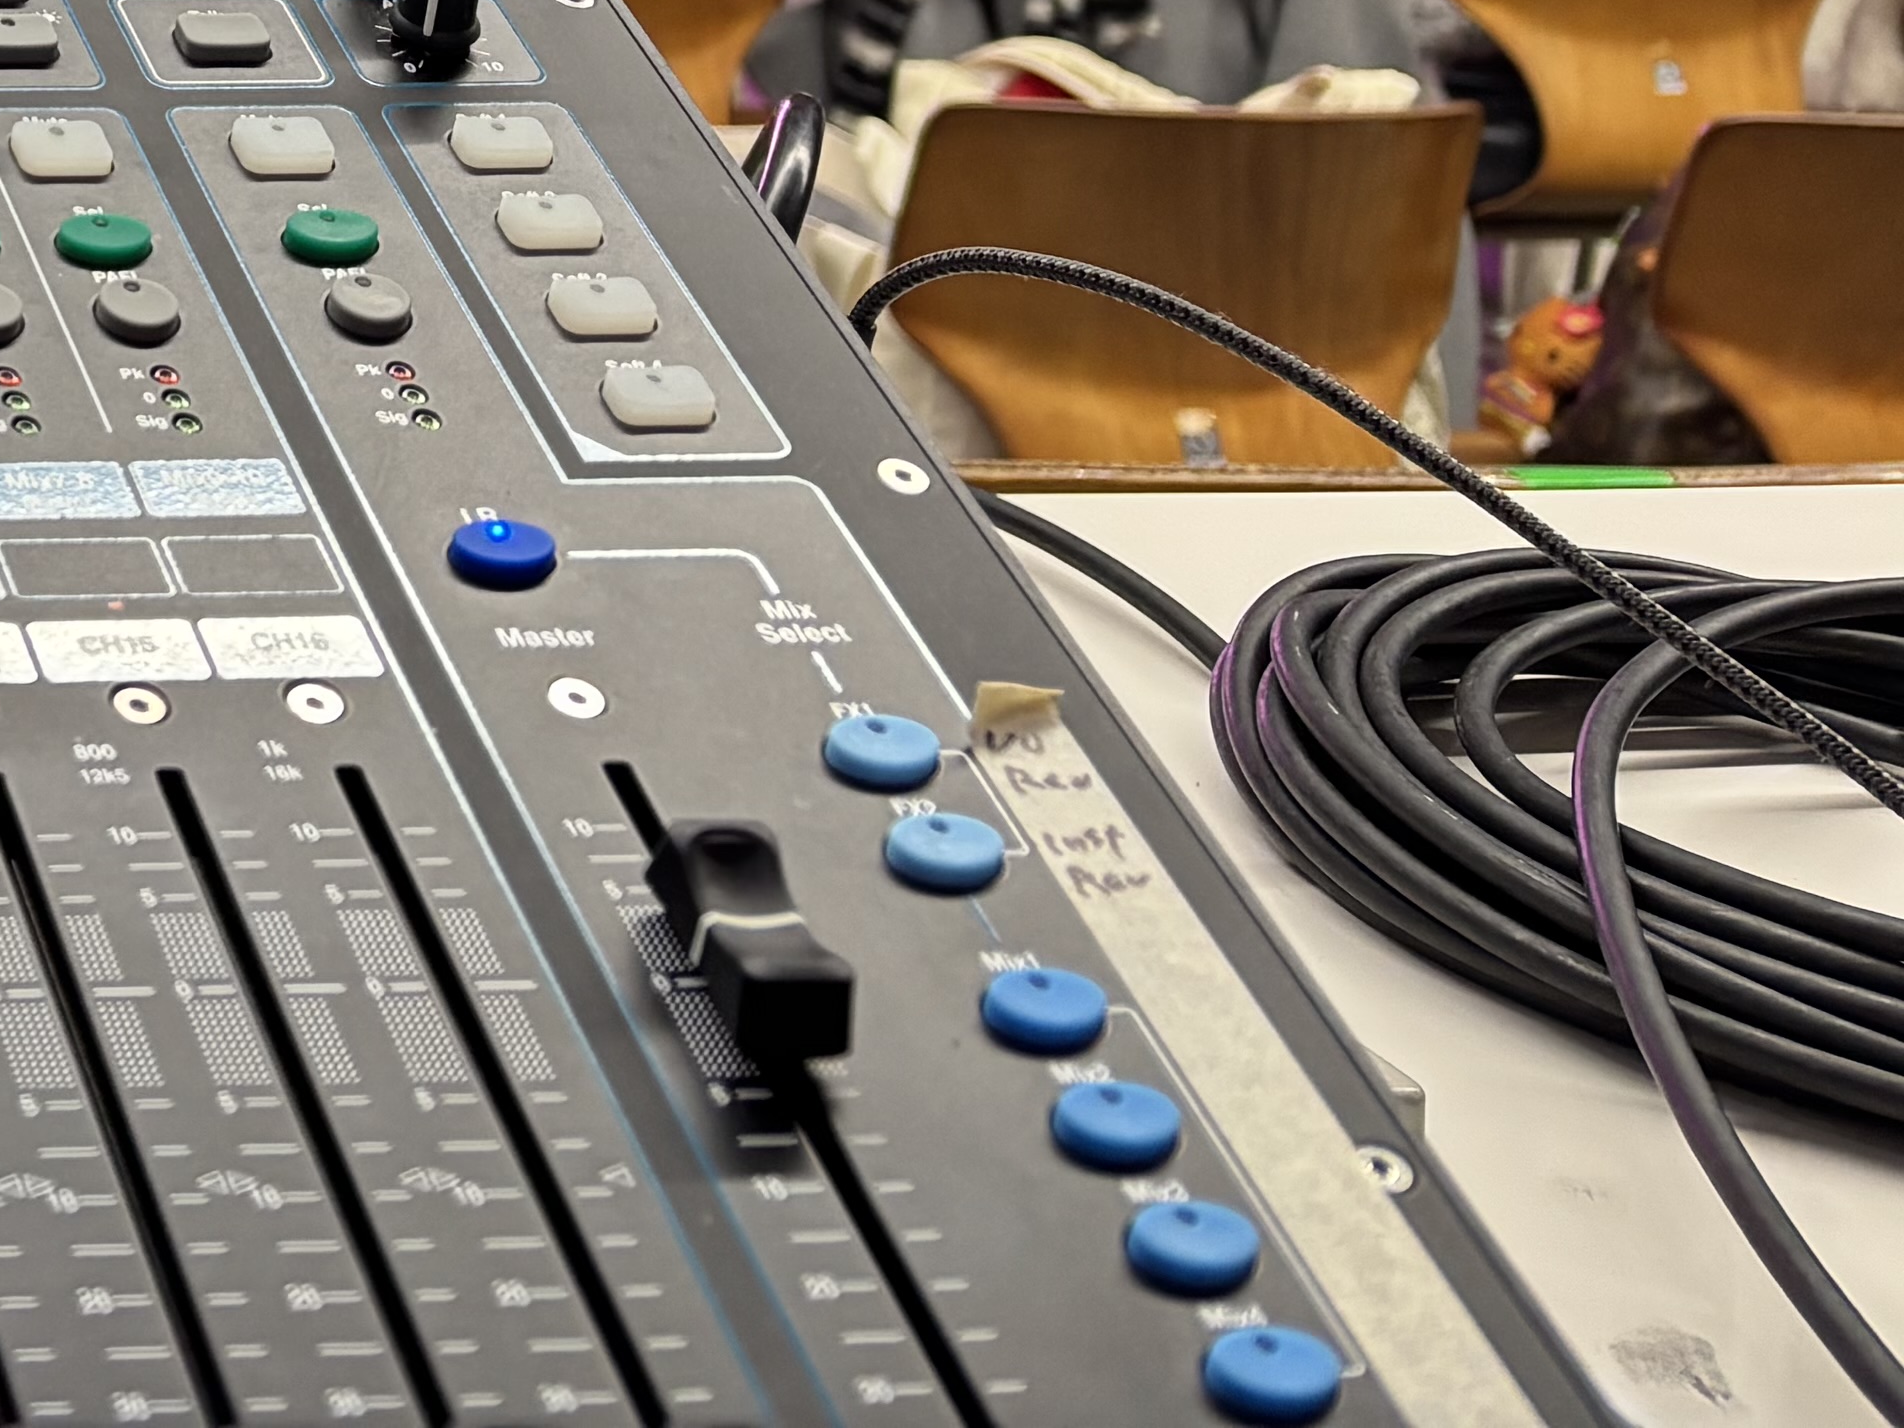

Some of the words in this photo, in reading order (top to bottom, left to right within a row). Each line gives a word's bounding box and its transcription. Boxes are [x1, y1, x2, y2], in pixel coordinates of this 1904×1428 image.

[403, 62, 417, 73] 0
[482, 61, 504, 72] 10
[759, 599, 817, 625] Mix
[494, 627, 595, 648] Master
[755, 622, 852, 644] Select
[250, 631, 330, 655] CH16
[73, 743, 117, 761] 800
[257, 739, 288, 757] 1k
[80, 768, 131, 784] 12k5
